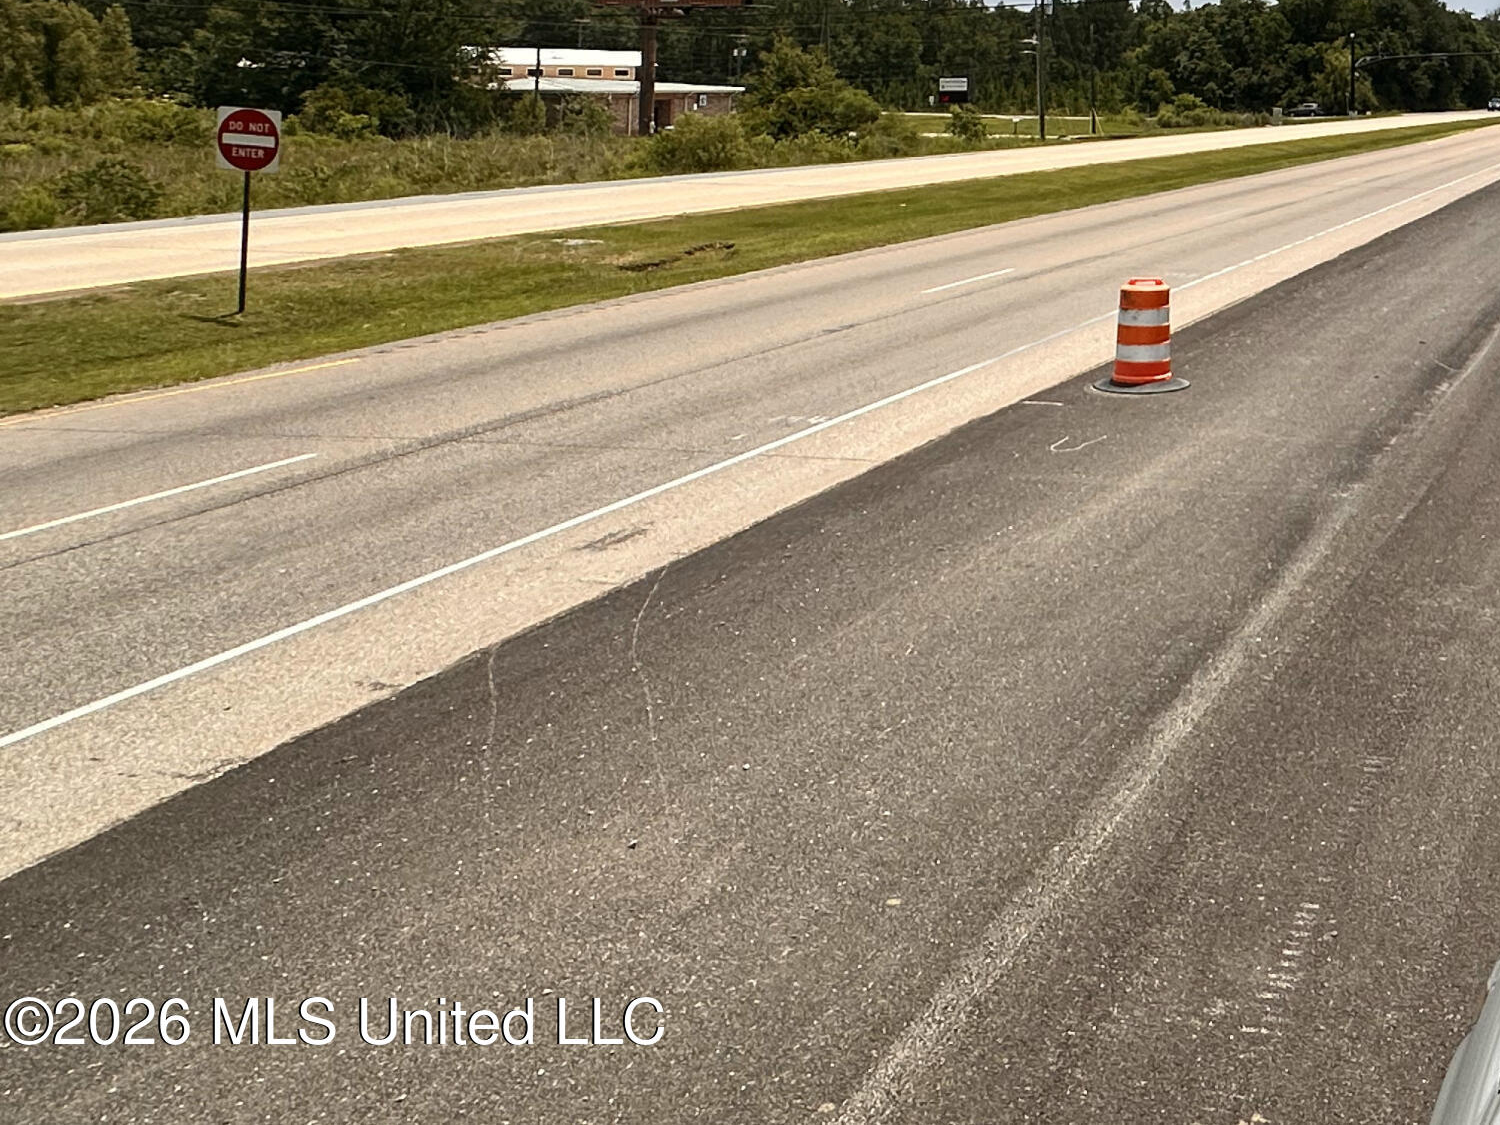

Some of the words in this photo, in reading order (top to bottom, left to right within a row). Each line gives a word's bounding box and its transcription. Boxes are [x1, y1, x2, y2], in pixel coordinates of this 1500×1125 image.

[229, 122, 243, 131] DO
[249, 123, 270, 133] NOT
[232, 147, 265, 158] ENTER
